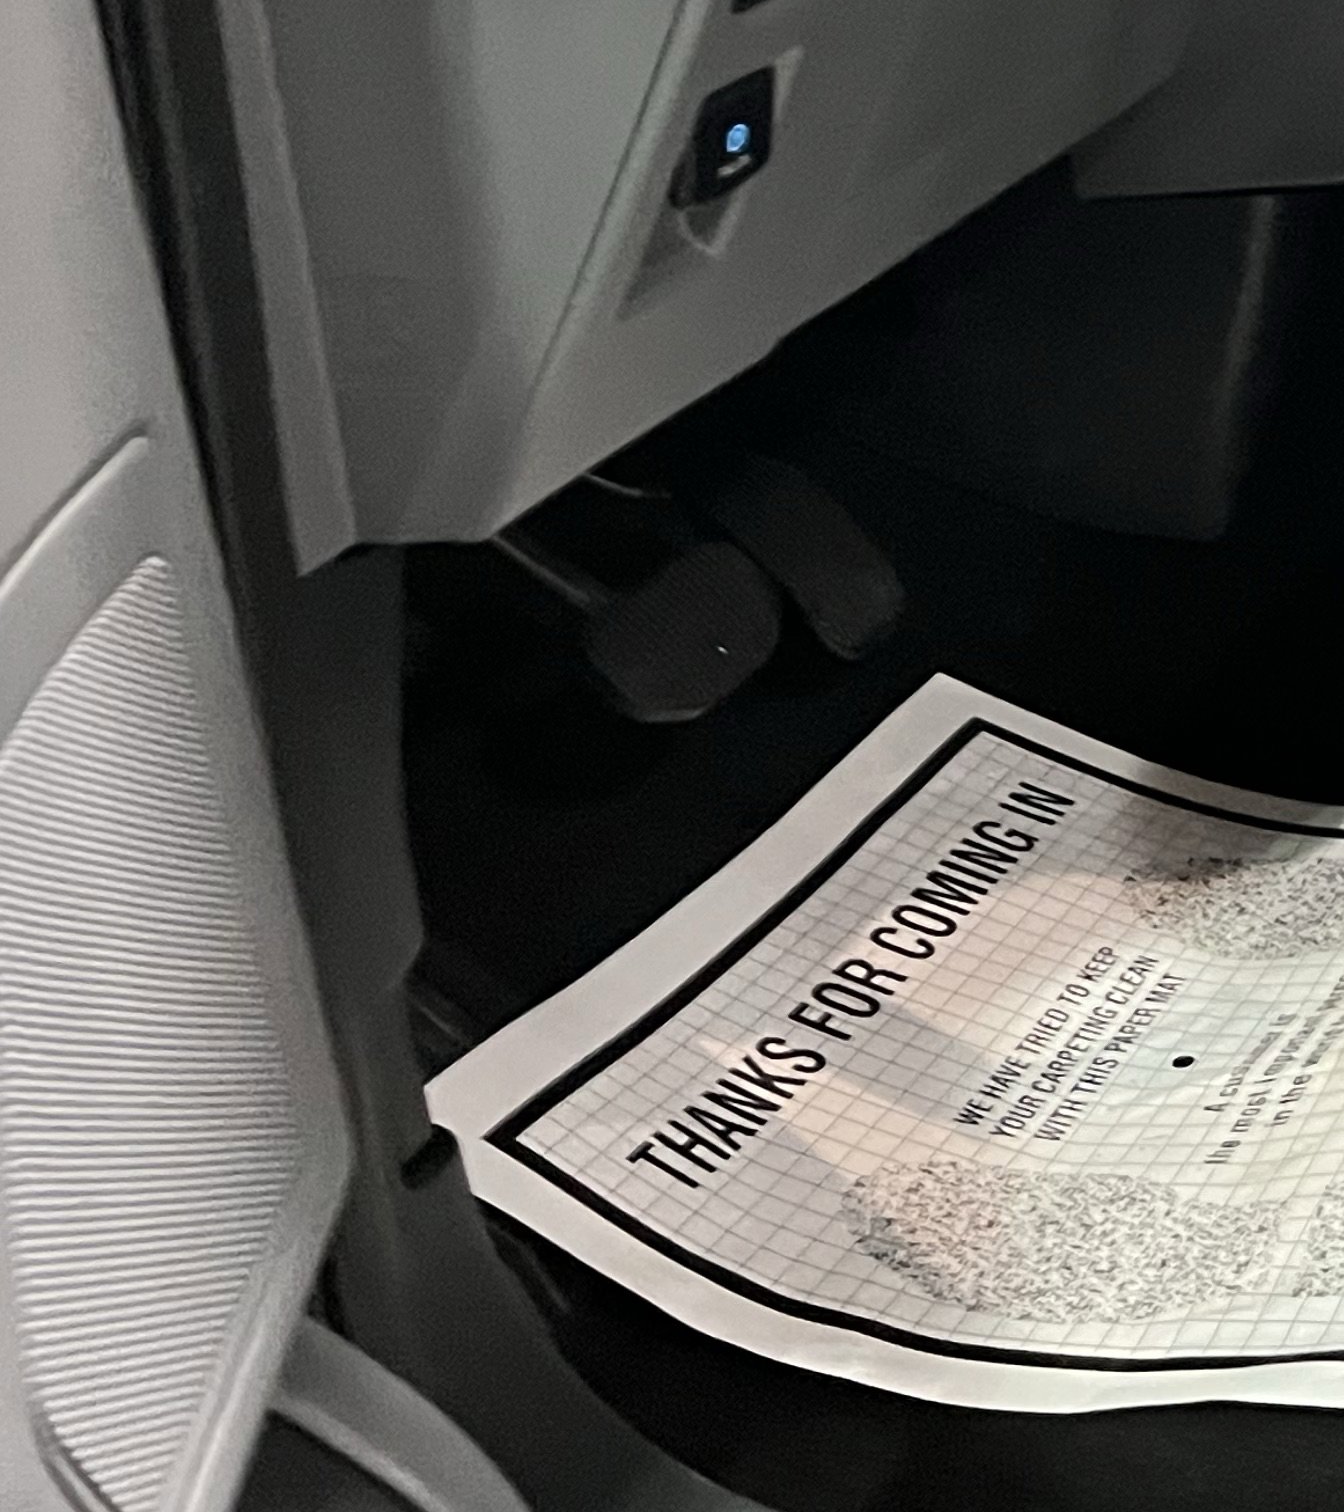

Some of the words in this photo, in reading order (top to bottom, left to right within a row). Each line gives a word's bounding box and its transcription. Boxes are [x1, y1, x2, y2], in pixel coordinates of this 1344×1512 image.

[626, 1037, 826, 1188] THANKS
[788, 959, 909, 1041] FOR
[869, 821, 1040, 959] COMING
[998, 782, 1075, 825] IN
[953, 1099, 993, 1126] WE
[979, 1056, 1031, 1099] HAVE
[1015, 1007, 1070, 1055] TRIED
[1056, 984, 1090, 1006] TO
[1077, 946, 1121, 982] KEEP
[989, 1095, 1047, 1138] YOUR
[1031, 1007, 1117, 1094] CARPETING
[1105, 955, 1160, 1005] CLEAN
[1034, 1099, 1088, 1141] WITH
[1070, 1057, 1120, 1094] THIS
[1104, 1008, 1162, 1053] PAPER
[1144, 973, 1186, 1004] MAT
[1279, 1074, 1313, 1104] the
